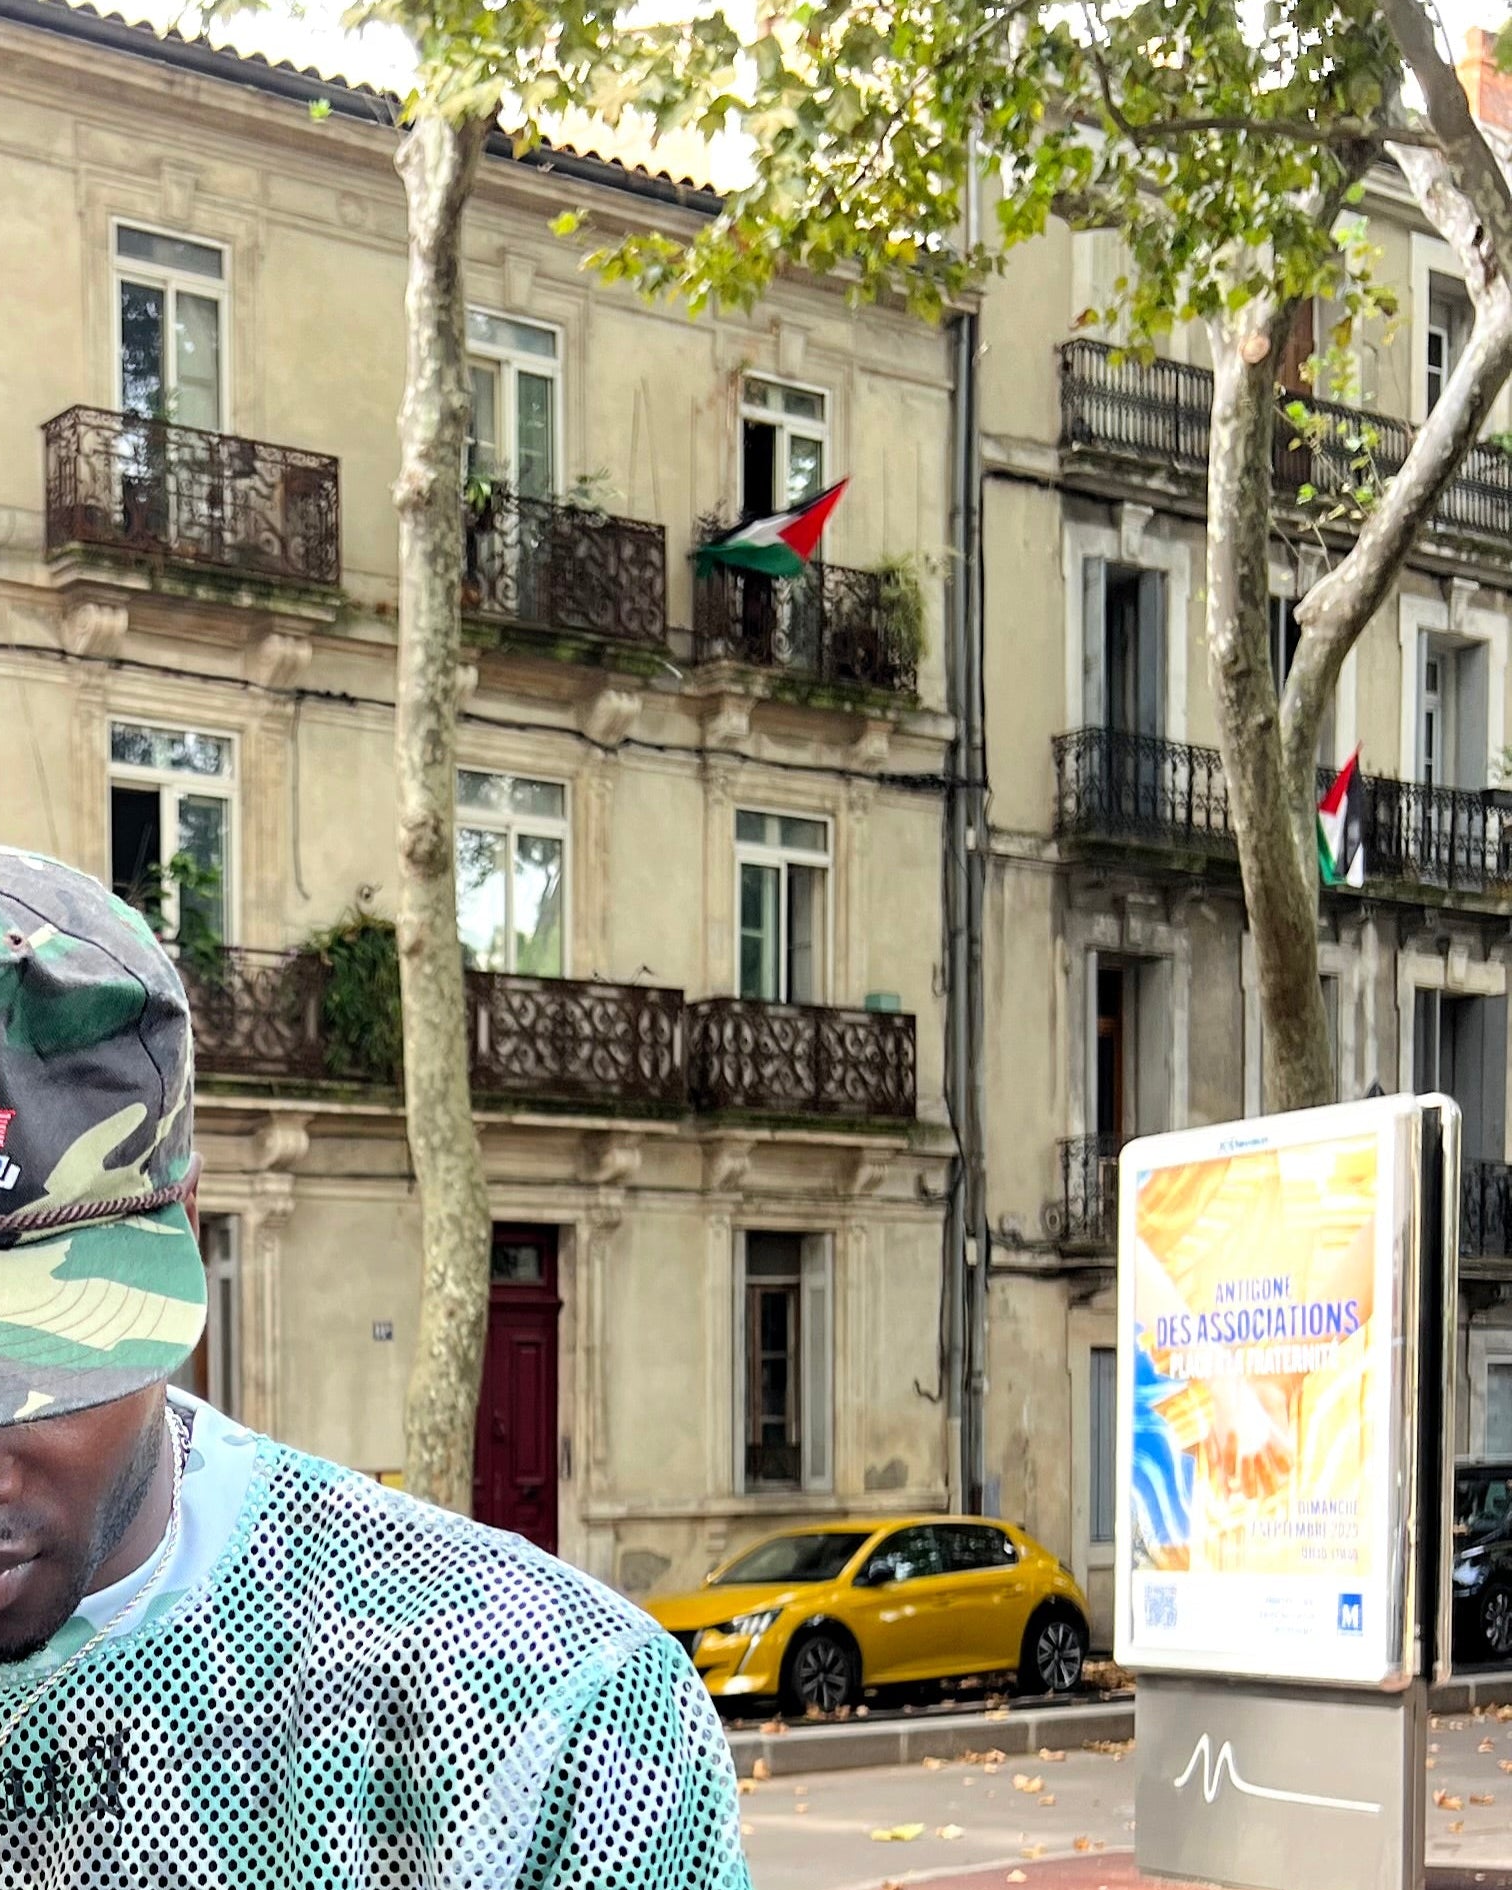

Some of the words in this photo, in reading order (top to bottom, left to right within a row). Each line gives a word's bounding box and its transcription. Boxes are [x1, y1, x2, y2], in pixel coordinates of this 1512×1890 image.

[1215, 1274, 1292, 1304] ANTIGONE
[1157, 1314, 1192, 1347] DES
[1197, 1300, 1360, 1345] ASSOCIATIONS
